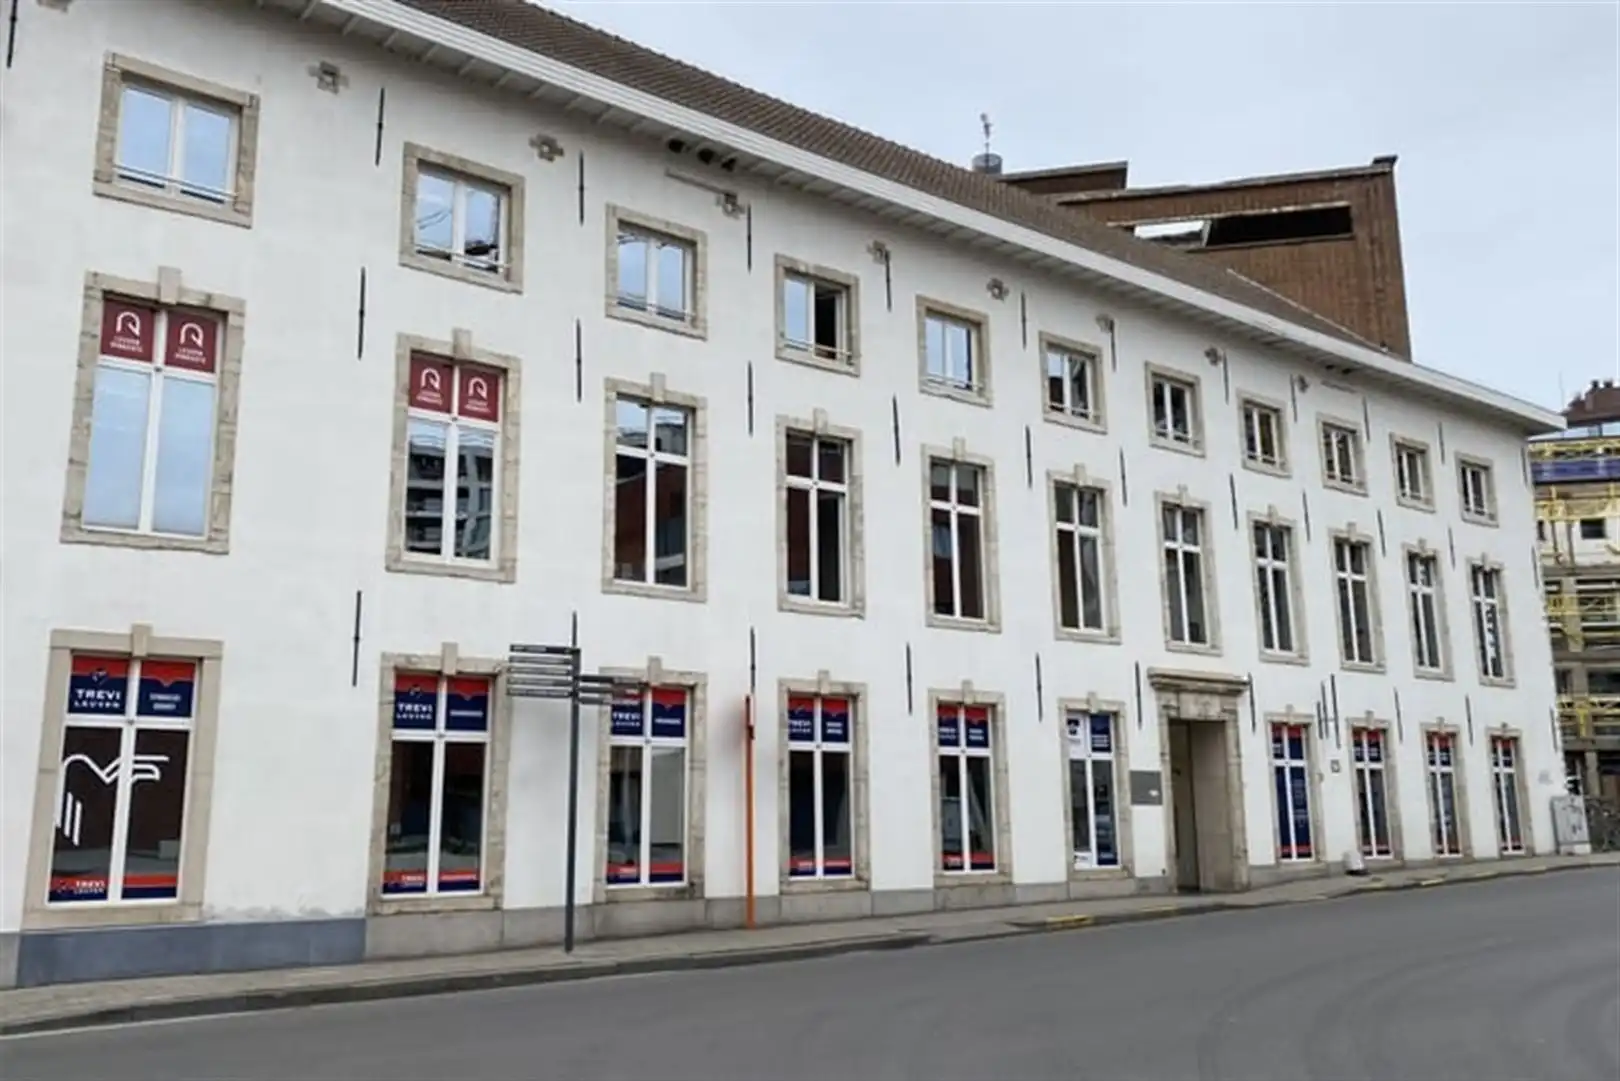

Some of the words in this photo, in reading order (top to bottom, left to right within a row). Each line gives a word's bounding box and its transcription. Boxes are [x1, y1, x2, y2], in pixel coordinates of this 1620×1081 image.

[75, 688, 121, 700] TREVI
[74, 700, 120, 708] LEUVEN
[397, 702, 433, 712] TREVI
[75, 880, 105, 888] TREVI
